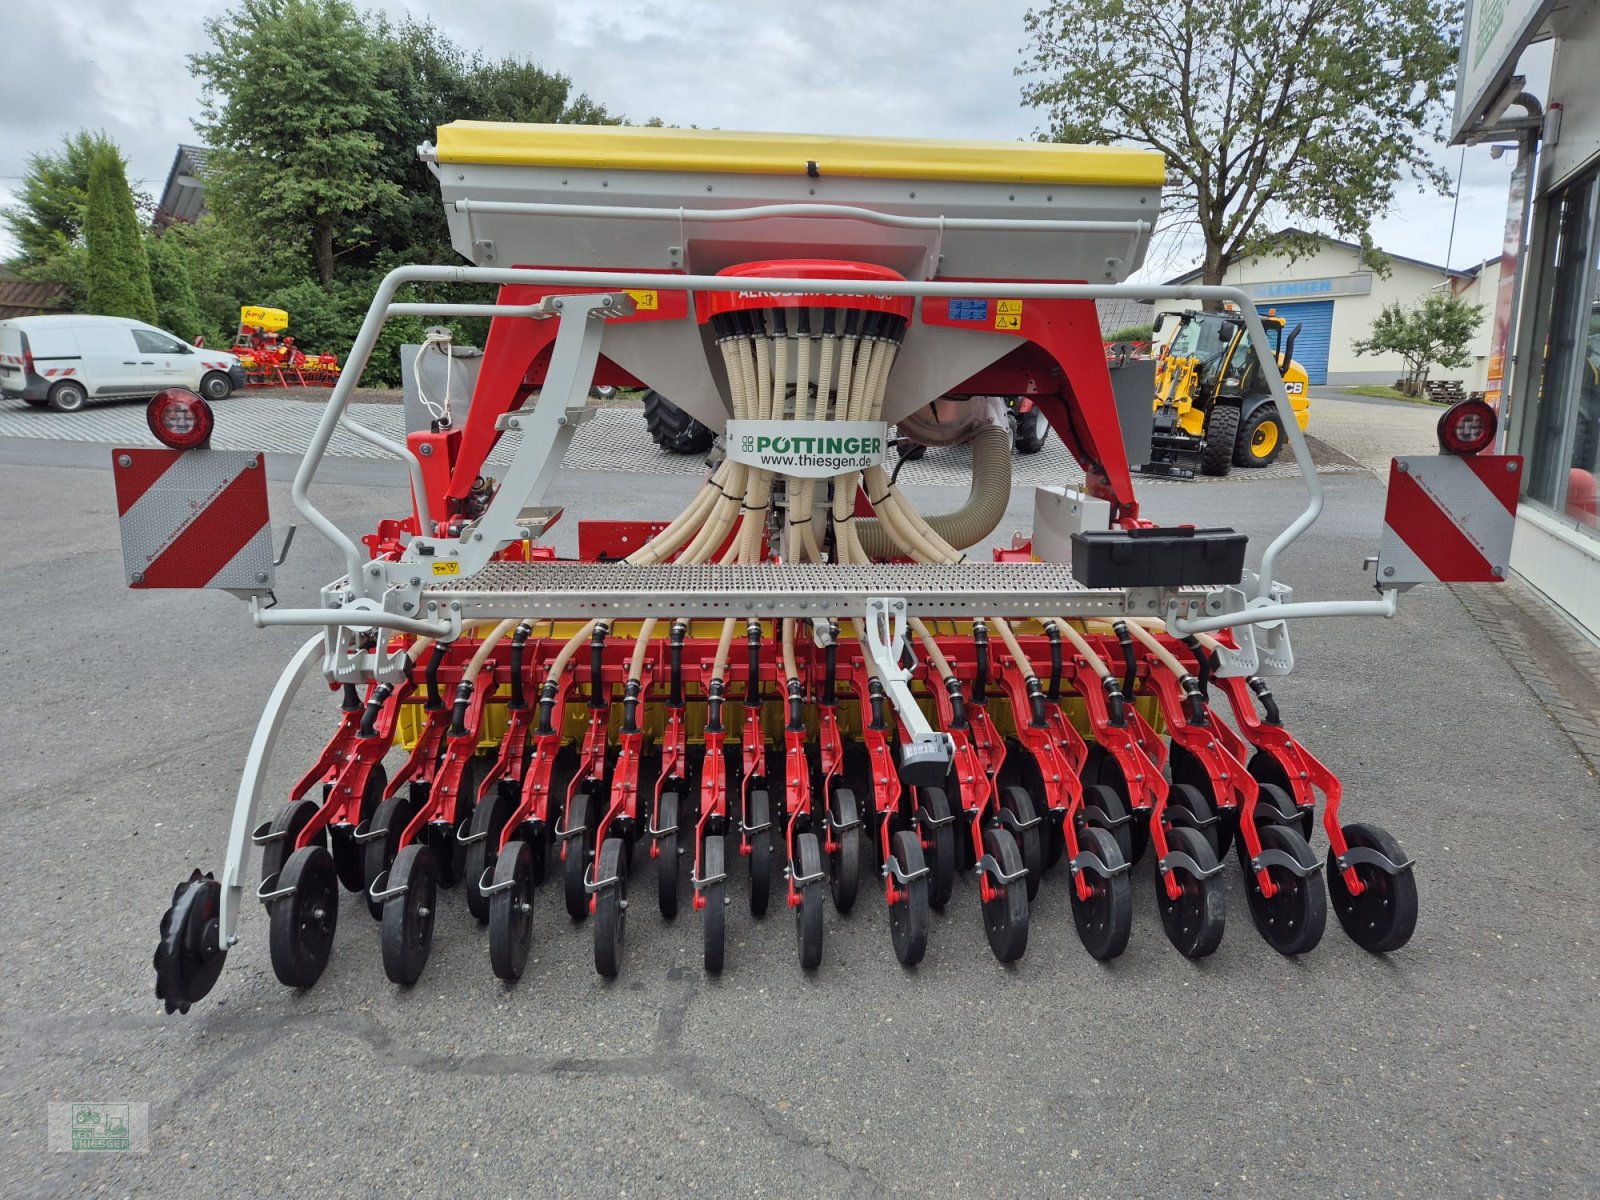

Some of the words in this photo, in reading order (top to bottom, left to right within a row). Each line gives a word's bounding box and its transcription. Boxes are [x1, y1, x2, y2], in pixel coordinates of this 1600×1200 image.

[1267, 280, 1332, 297] LEMKEN
[1283, 382, 1303, 394] CB
[757, 436, 881, 454] PÖTTINGER
[760, 454, 872, 470] www.thiesgen.de
